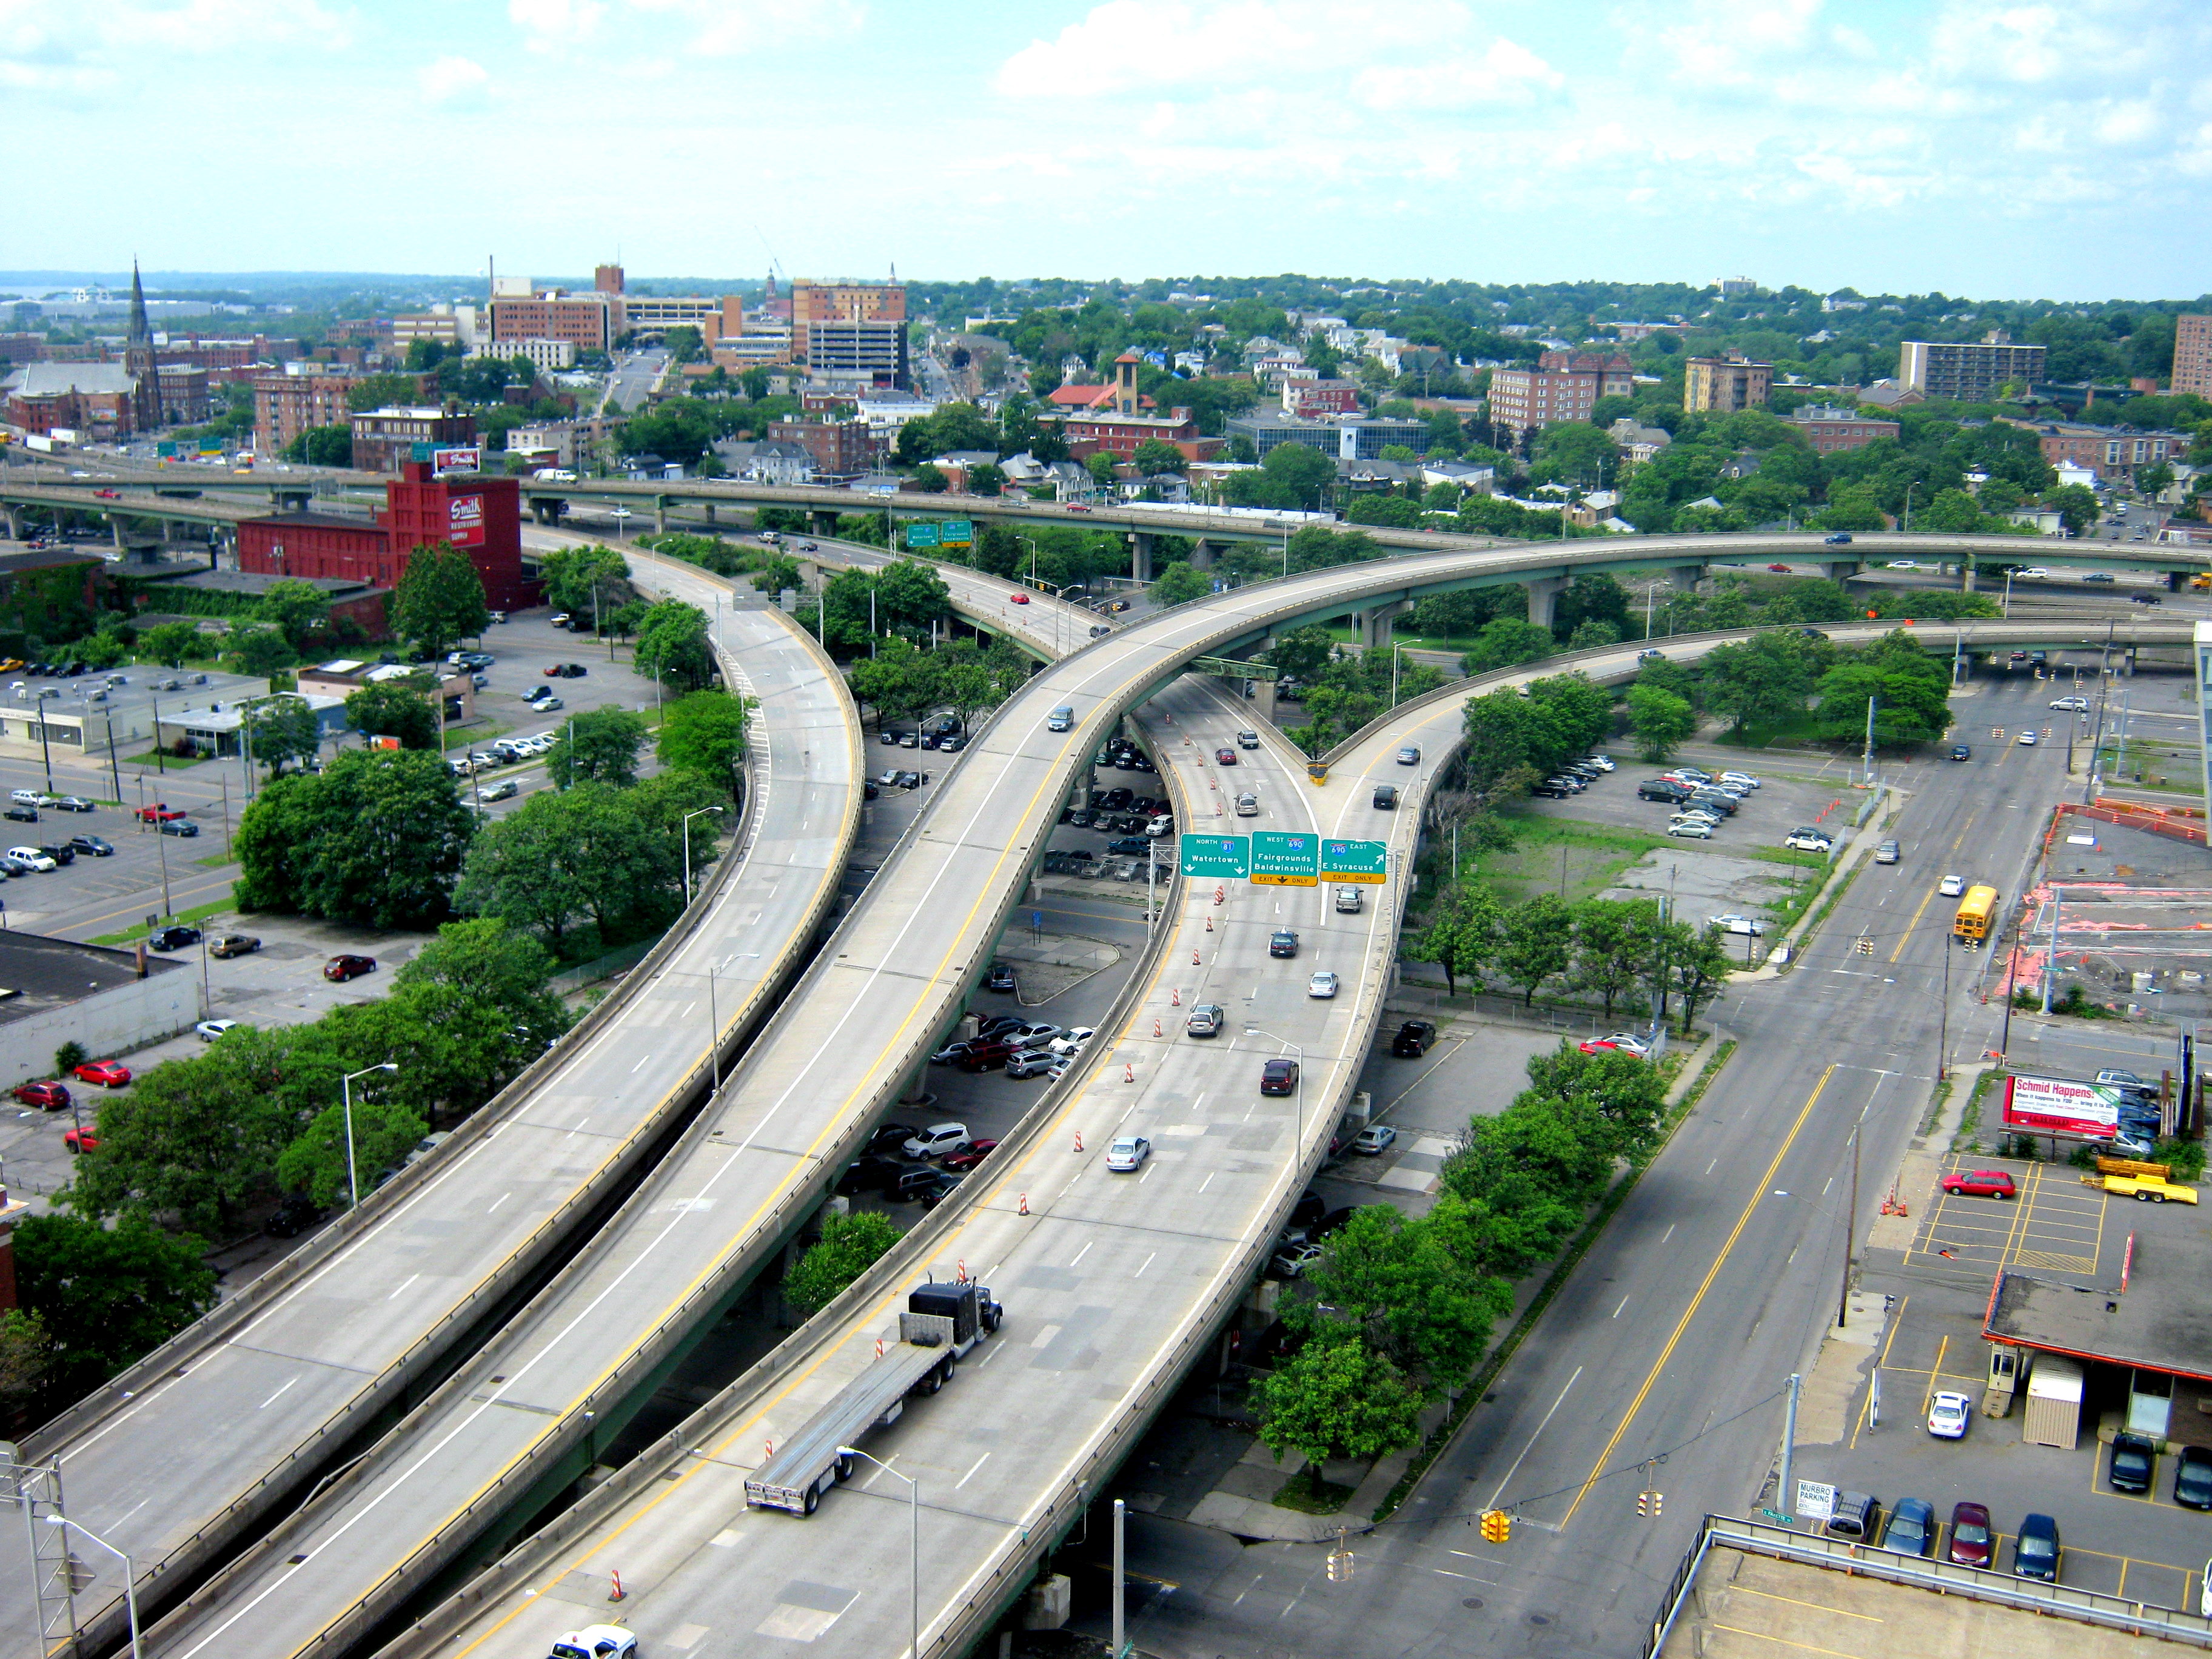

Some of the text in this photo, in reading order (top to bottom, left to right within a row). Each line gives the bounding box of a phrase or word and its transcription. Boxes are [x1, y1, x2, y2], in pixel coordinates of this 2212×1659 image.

[451, 497, 481, 520] Smith
[1191, 855, 1239, 863] Watertown
[1258, 853, 1311, 862] Fairgrounds
[1254, 863, 1314, 873] Baldwinsville
[1332, 862, 1373, 871] Syracuse
[2016, 1079, 2050, 1093] Schmid
[2052, 1083, 2094, 1099] Happens!
[1800, 1483, 1831, 1495] MURBRO
[1800, 1491, 1830, 1503] PARKING
[1768, 1511, 1786, 1521] FAYETTE
